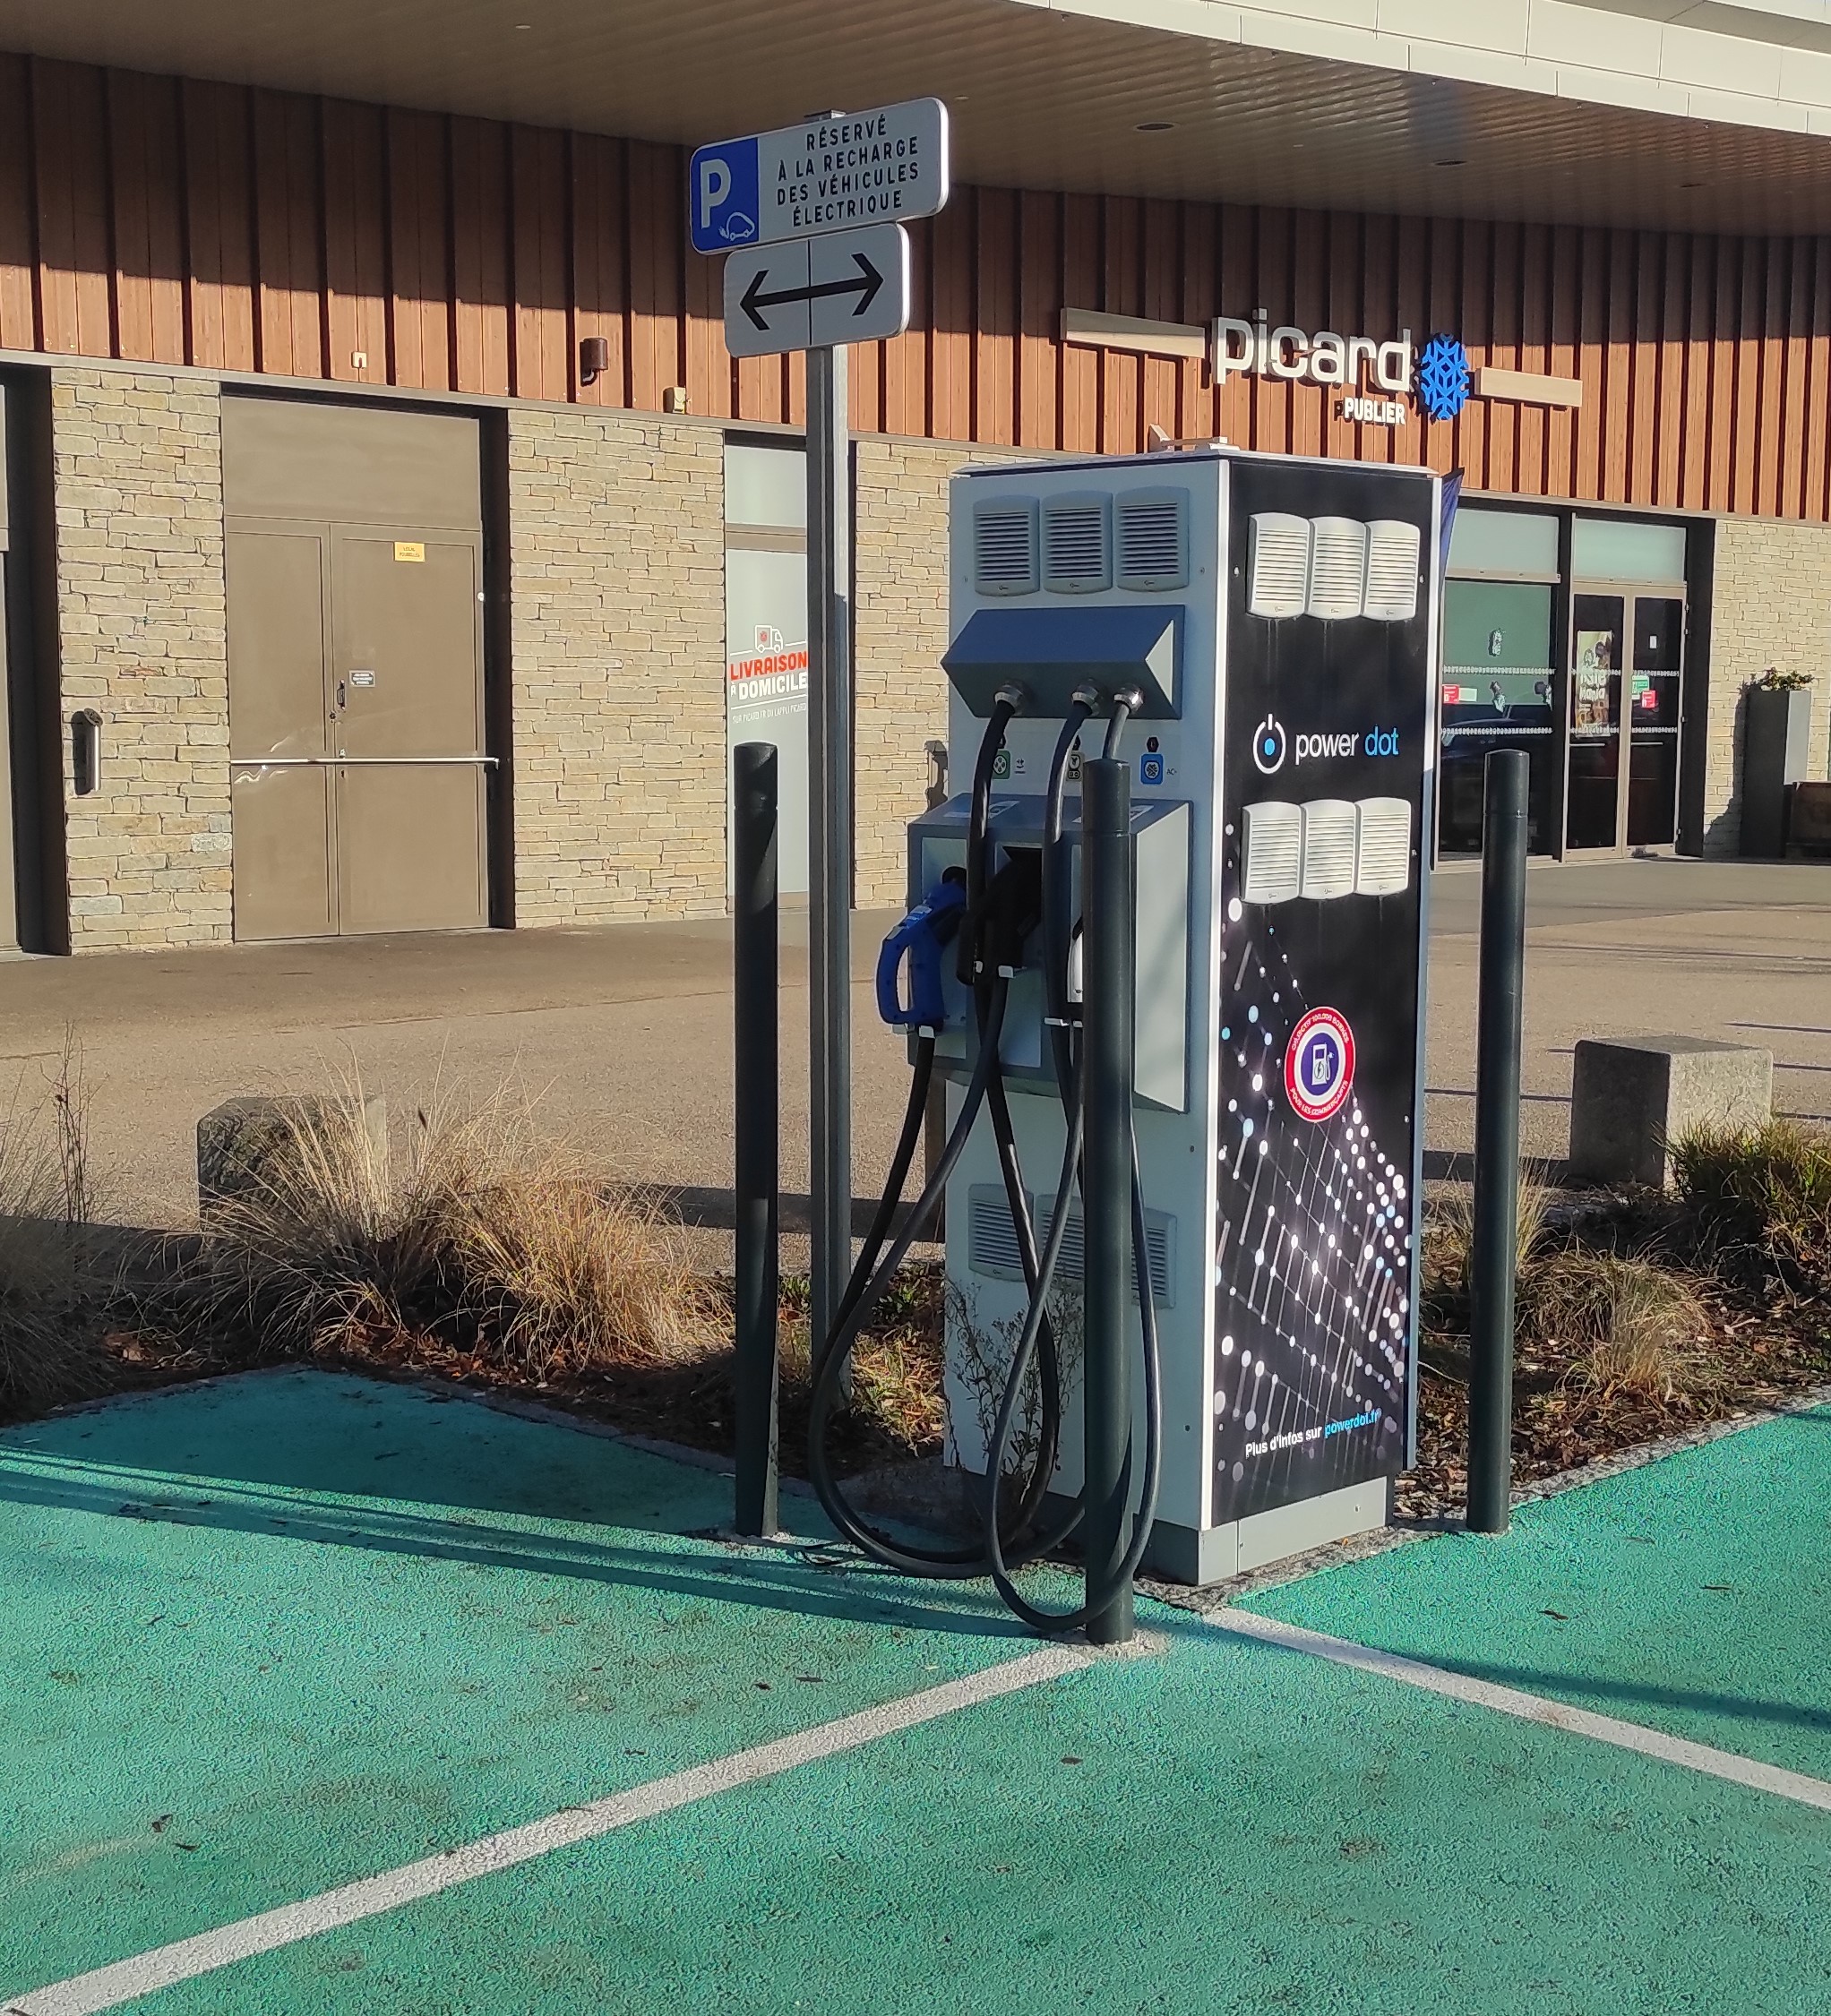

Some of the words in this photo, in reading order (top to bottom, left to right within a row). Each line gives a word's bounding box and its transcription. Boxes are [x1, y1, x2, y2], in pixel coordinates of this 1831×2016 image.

[807, 114, 887, 151] RÉSERVÉ
[778, 159, 787, 182] À
[796, 158, 814, 178] LA
[824, 136, 919, 172] RECHARGE
[701, 159, 732, 229] P
[778, 184, 809, 206] DES
[818, 162, 919, 198] VÉHICULES
[793, 190, 902, 227] ÉLECTRIQUE
[1212, 307, 1412, 391] picard
[1345, 397, 1405, 425] PUBLIER
[730, 651, 809, 681] LIVRAISON
[738, 672, 808, 700] DOMICILE
[1295, 733, 1360, 766] power
[1364, 725, 1399, 756] dot
[1245, 1443, 1268, 1459] Plus
[1305, 1426, 1323, 1441] sur
